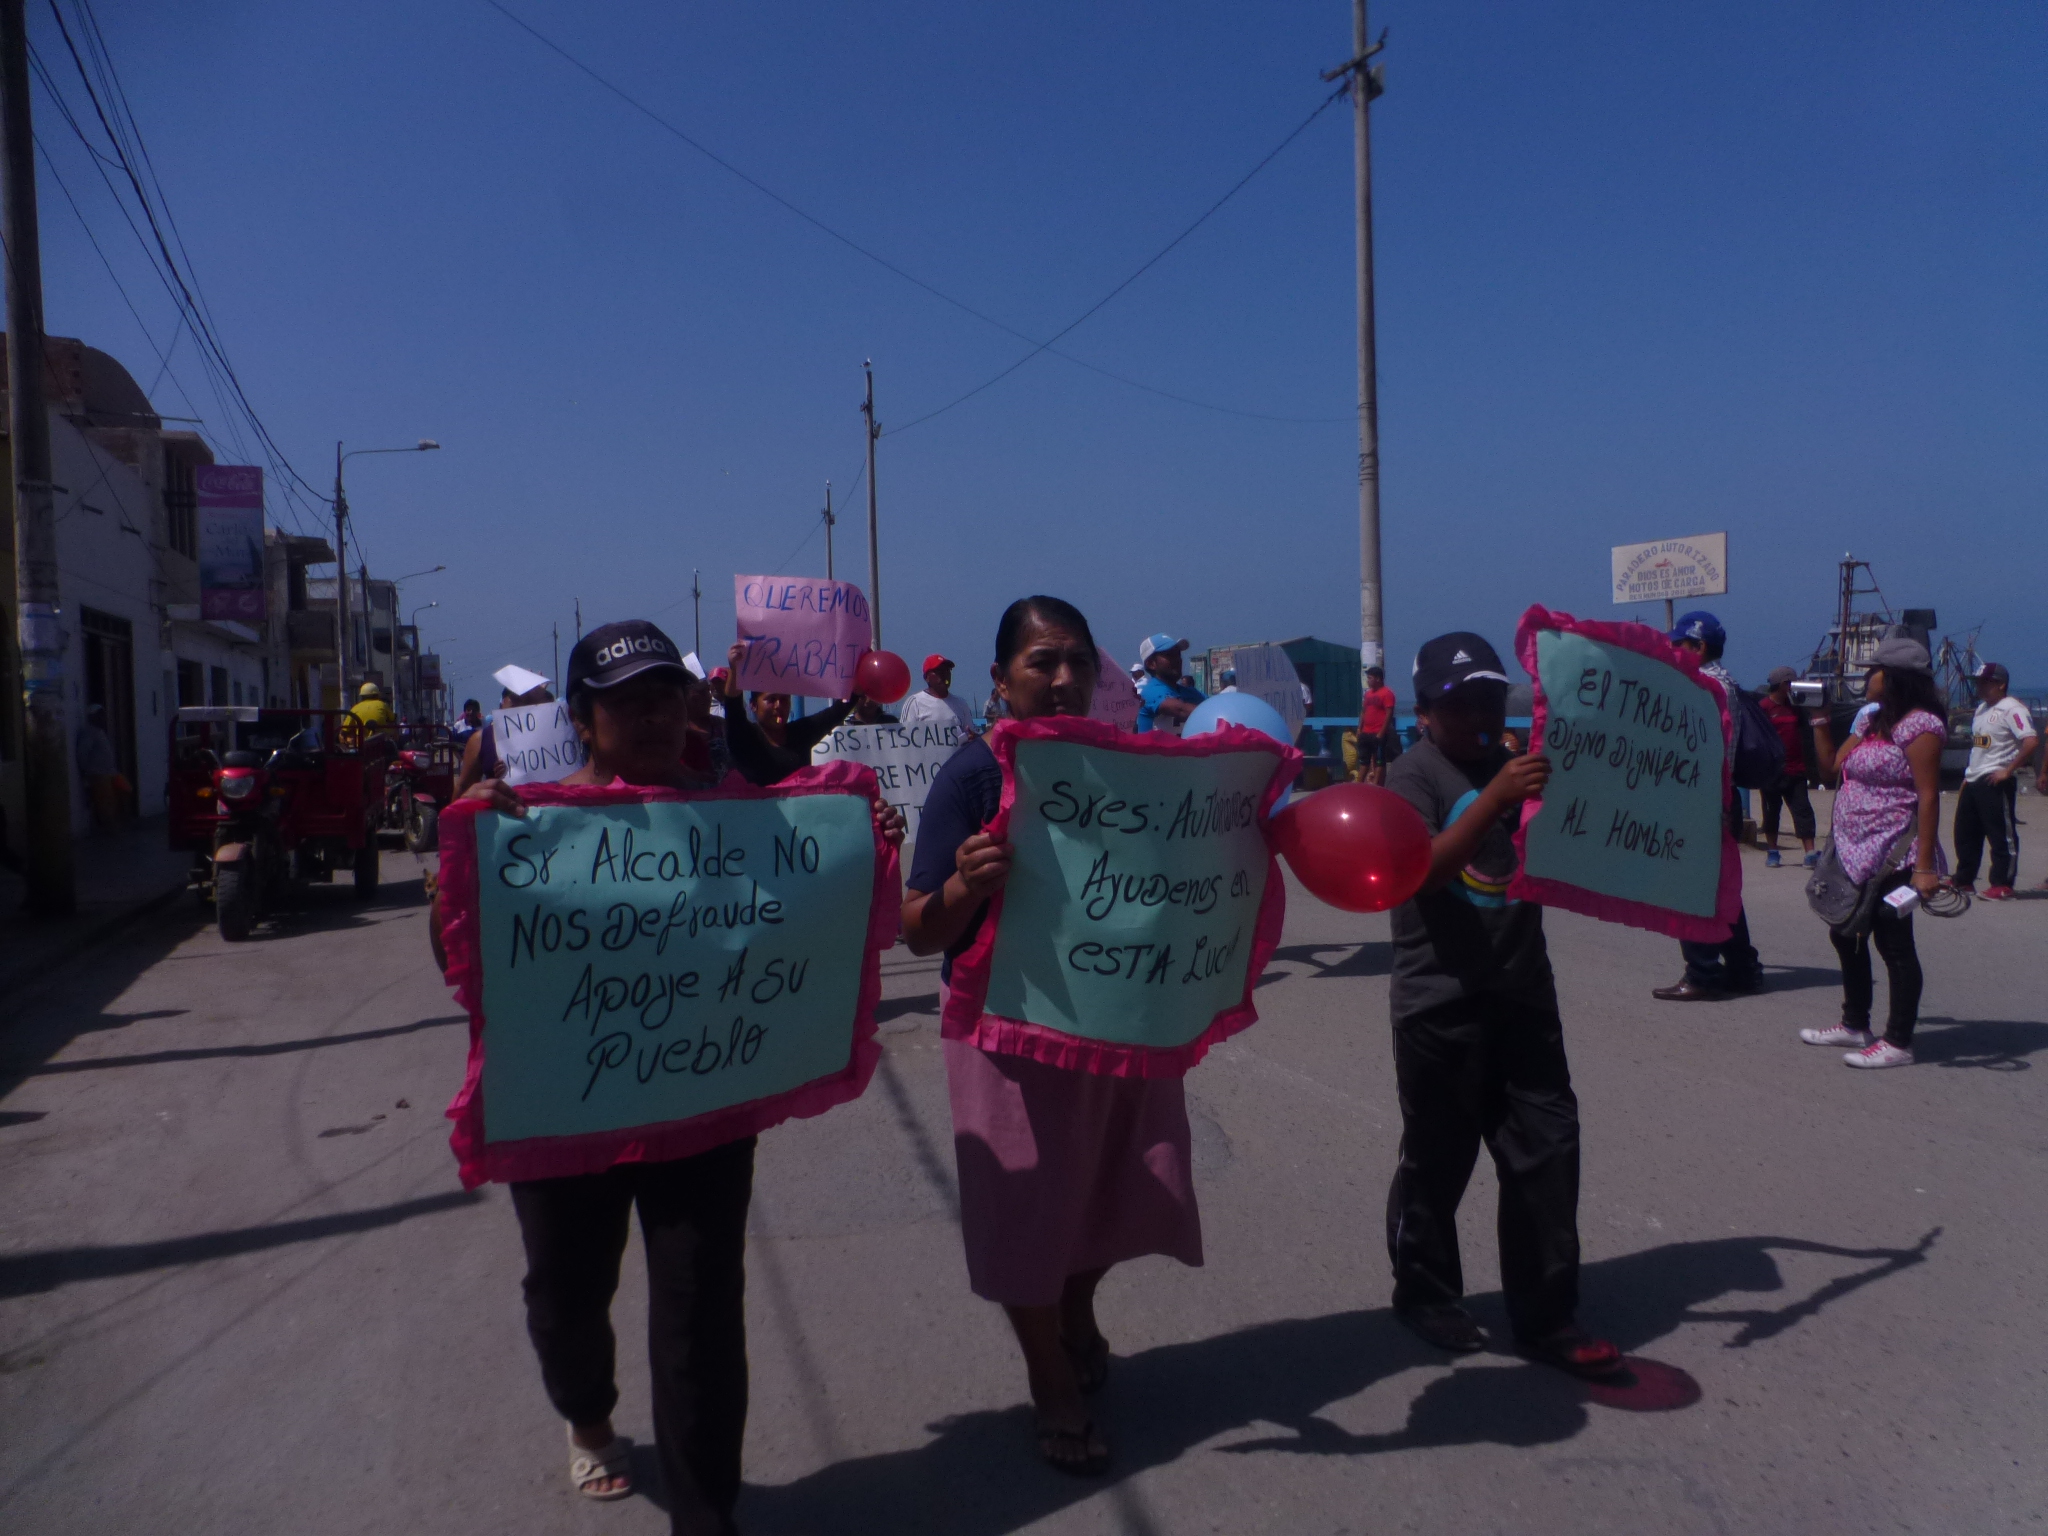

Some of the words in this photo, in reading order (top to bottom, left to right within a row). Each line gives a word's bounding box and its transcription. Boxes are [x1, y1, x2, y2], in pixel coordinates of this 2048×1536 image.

[1616, 545, 1659, 592] PARADERO
[1660, 542, 1720, 581] AUTORIZADO
[1628, 580, 1659, 594] MOTOS
[1661, 578, 1673, 590] DE
[1674, 575, 1706, 588] CARGA
[1637, 569, 1658, 582] DIOS
[1660, 568, 1670, 580] ES
[1672, 565, 1696, 578] AMOR
[744, 582, 869, 622] QUEREMOS
[596, 635, 676, 666] adidas
[741, 634, 863, 680] TRABAJ
[503, 712, 536, 739] NO
[554, 705, 569, 729] A
[876, 723, 960, 751] FISCALES
[506, 739, 580, 778] MONO
[1560, 797, 1587, 838] AL
[591, 823, 745, 884] Alcalde
[774, 826, 820, 877] NO
[1230, 869, 1251, 898] en
[511, 904, 592, 968] NOS
[601, 880, 785, 956] Defraude
[718, 947, 750, 1002] A
[582, 1015, 767, 1102] Pueblo
